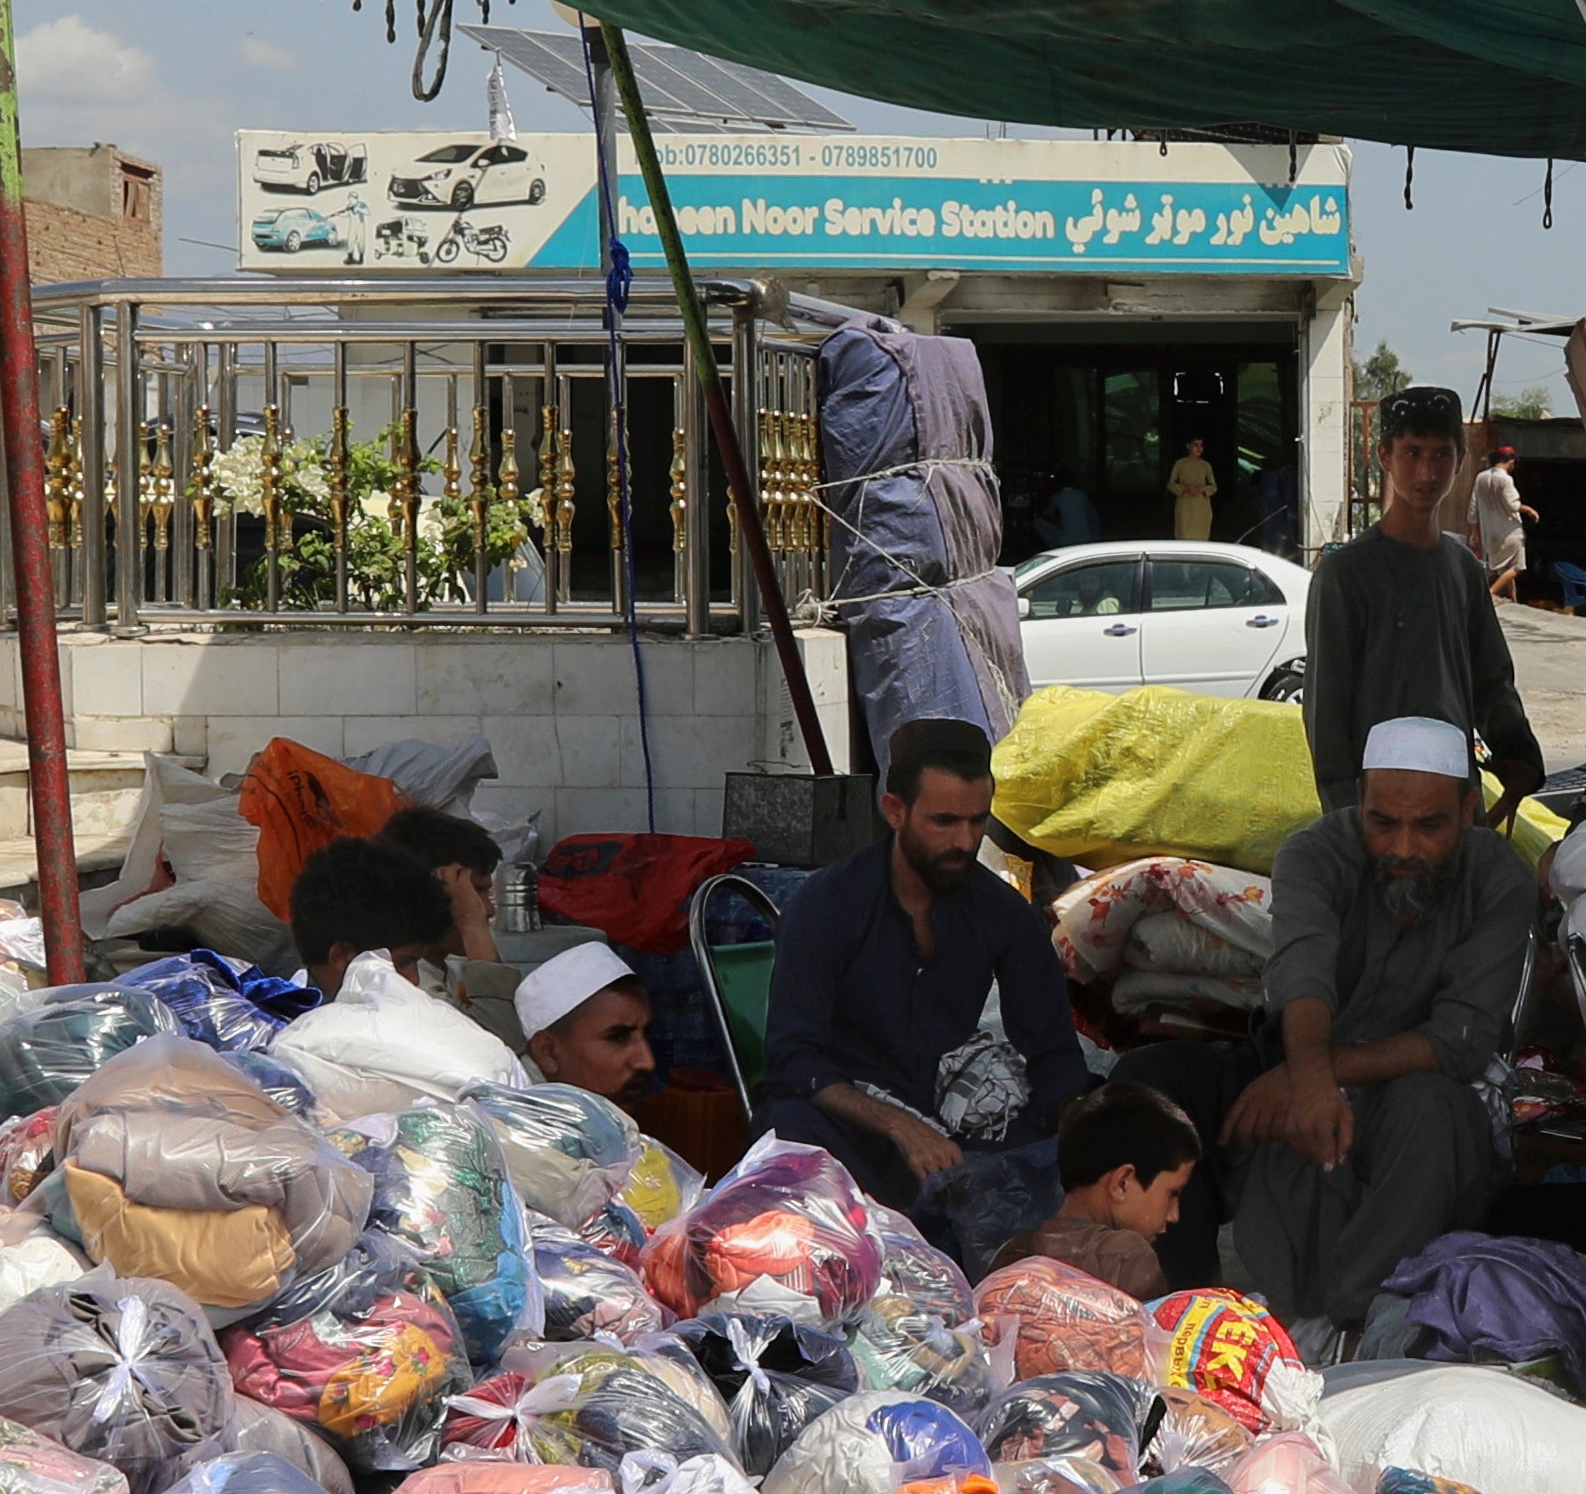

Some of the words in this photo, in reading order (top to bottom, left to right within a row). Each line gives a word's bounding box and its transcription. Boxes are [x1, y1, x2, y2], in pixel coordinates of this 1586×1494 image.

[634, 144, 801, 167] ob:0780266351
[822, 146, 938, 169] 0789851700
[617, 195, 736, 235] haeen
[742, 198, 819, 235] Noor
[824, 197, 935, 238] Service
[941, 199, 1055, 240] Station
[1209, 193, 1255, 245] نور
